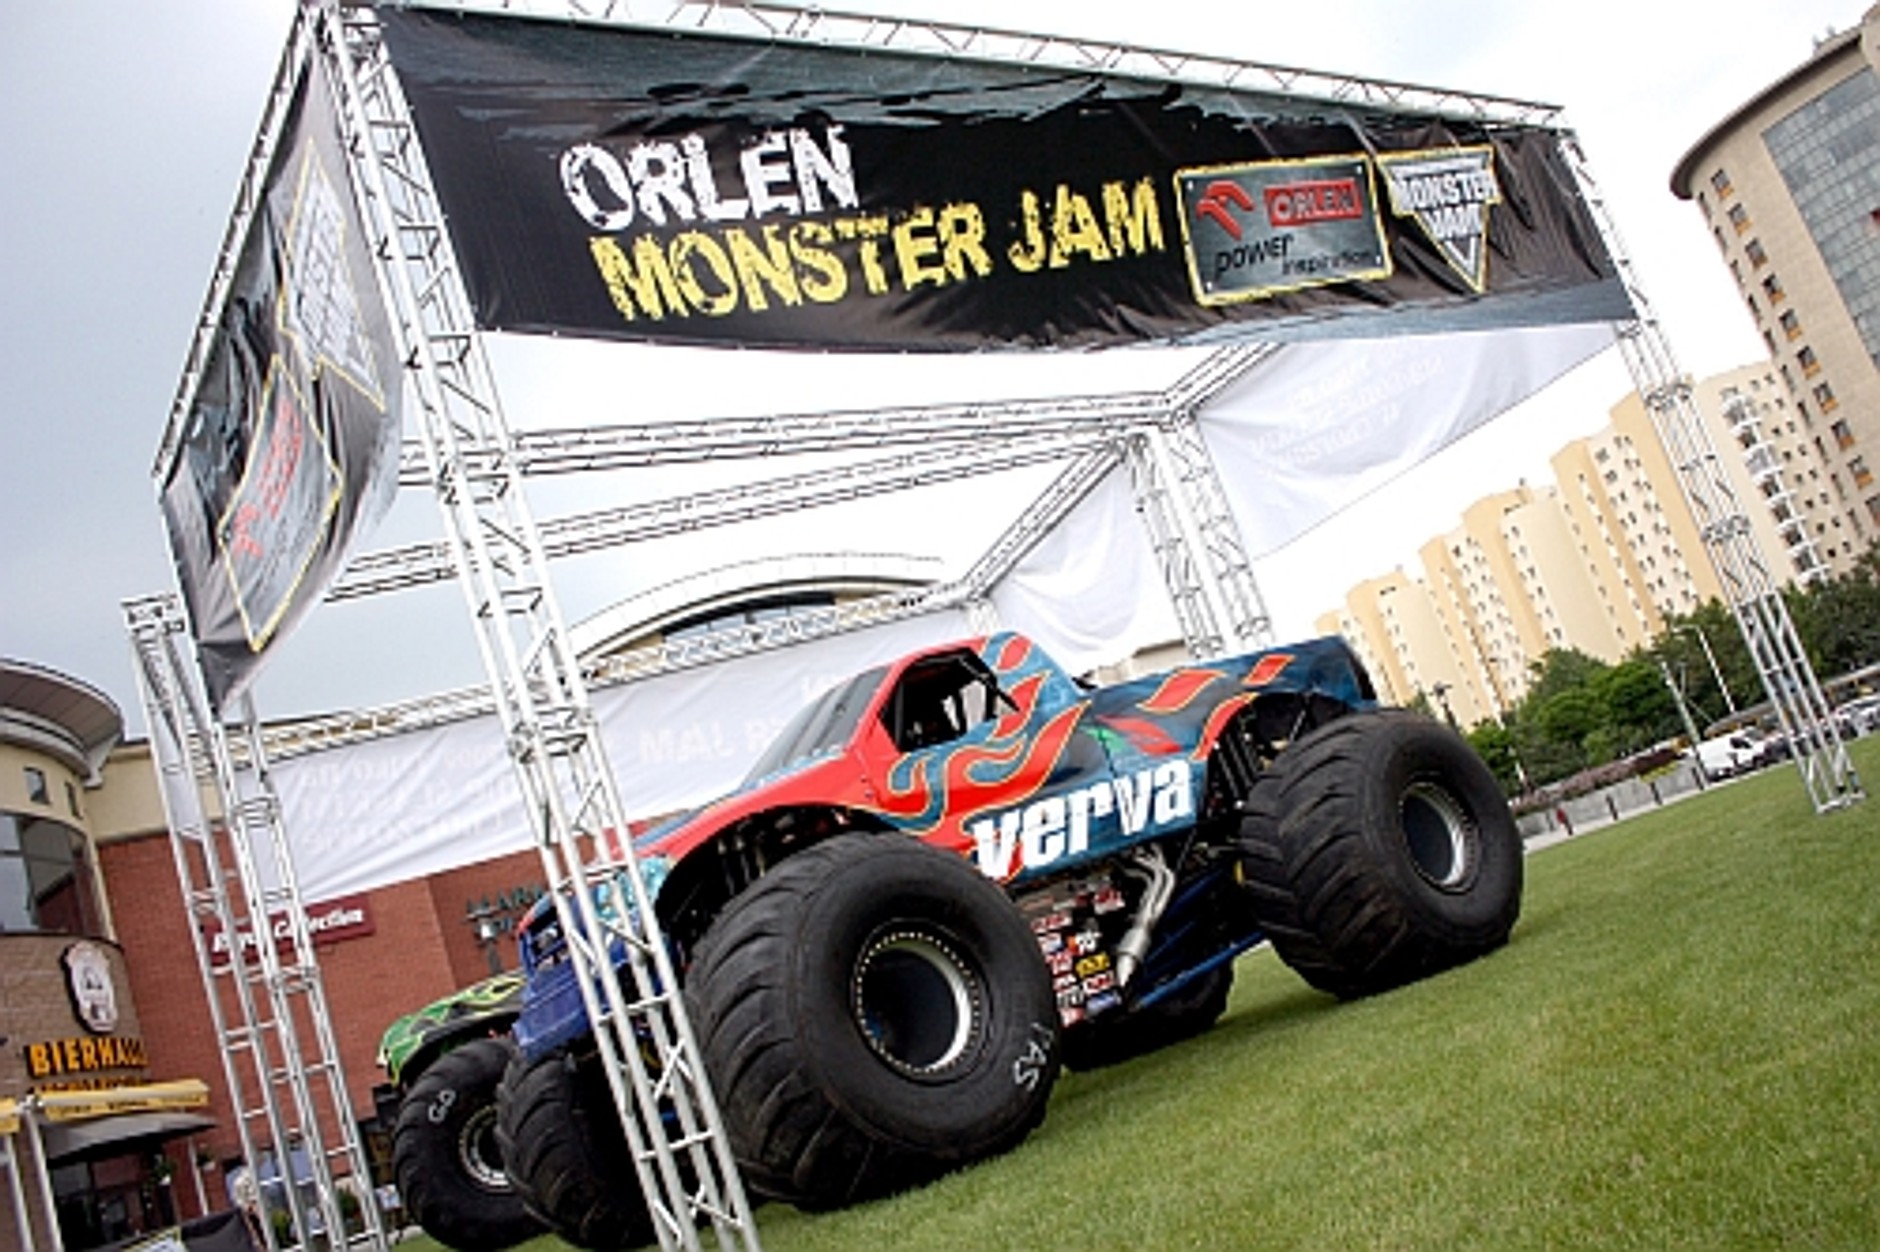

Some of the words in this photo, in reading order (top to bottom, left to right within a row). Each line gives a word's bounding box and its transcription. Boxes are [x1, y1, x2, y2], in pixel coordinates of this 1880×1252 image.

[559, 123, 860, 231] ORLEN
[1272, 185, 1356, 221] ORLEN
[590, 200, 993, 321] MONSTER
[1006, 176, 1165, 273] JAM
[1215, 233, 1294, 281] power
[973, 758, 1192, 881] verva
